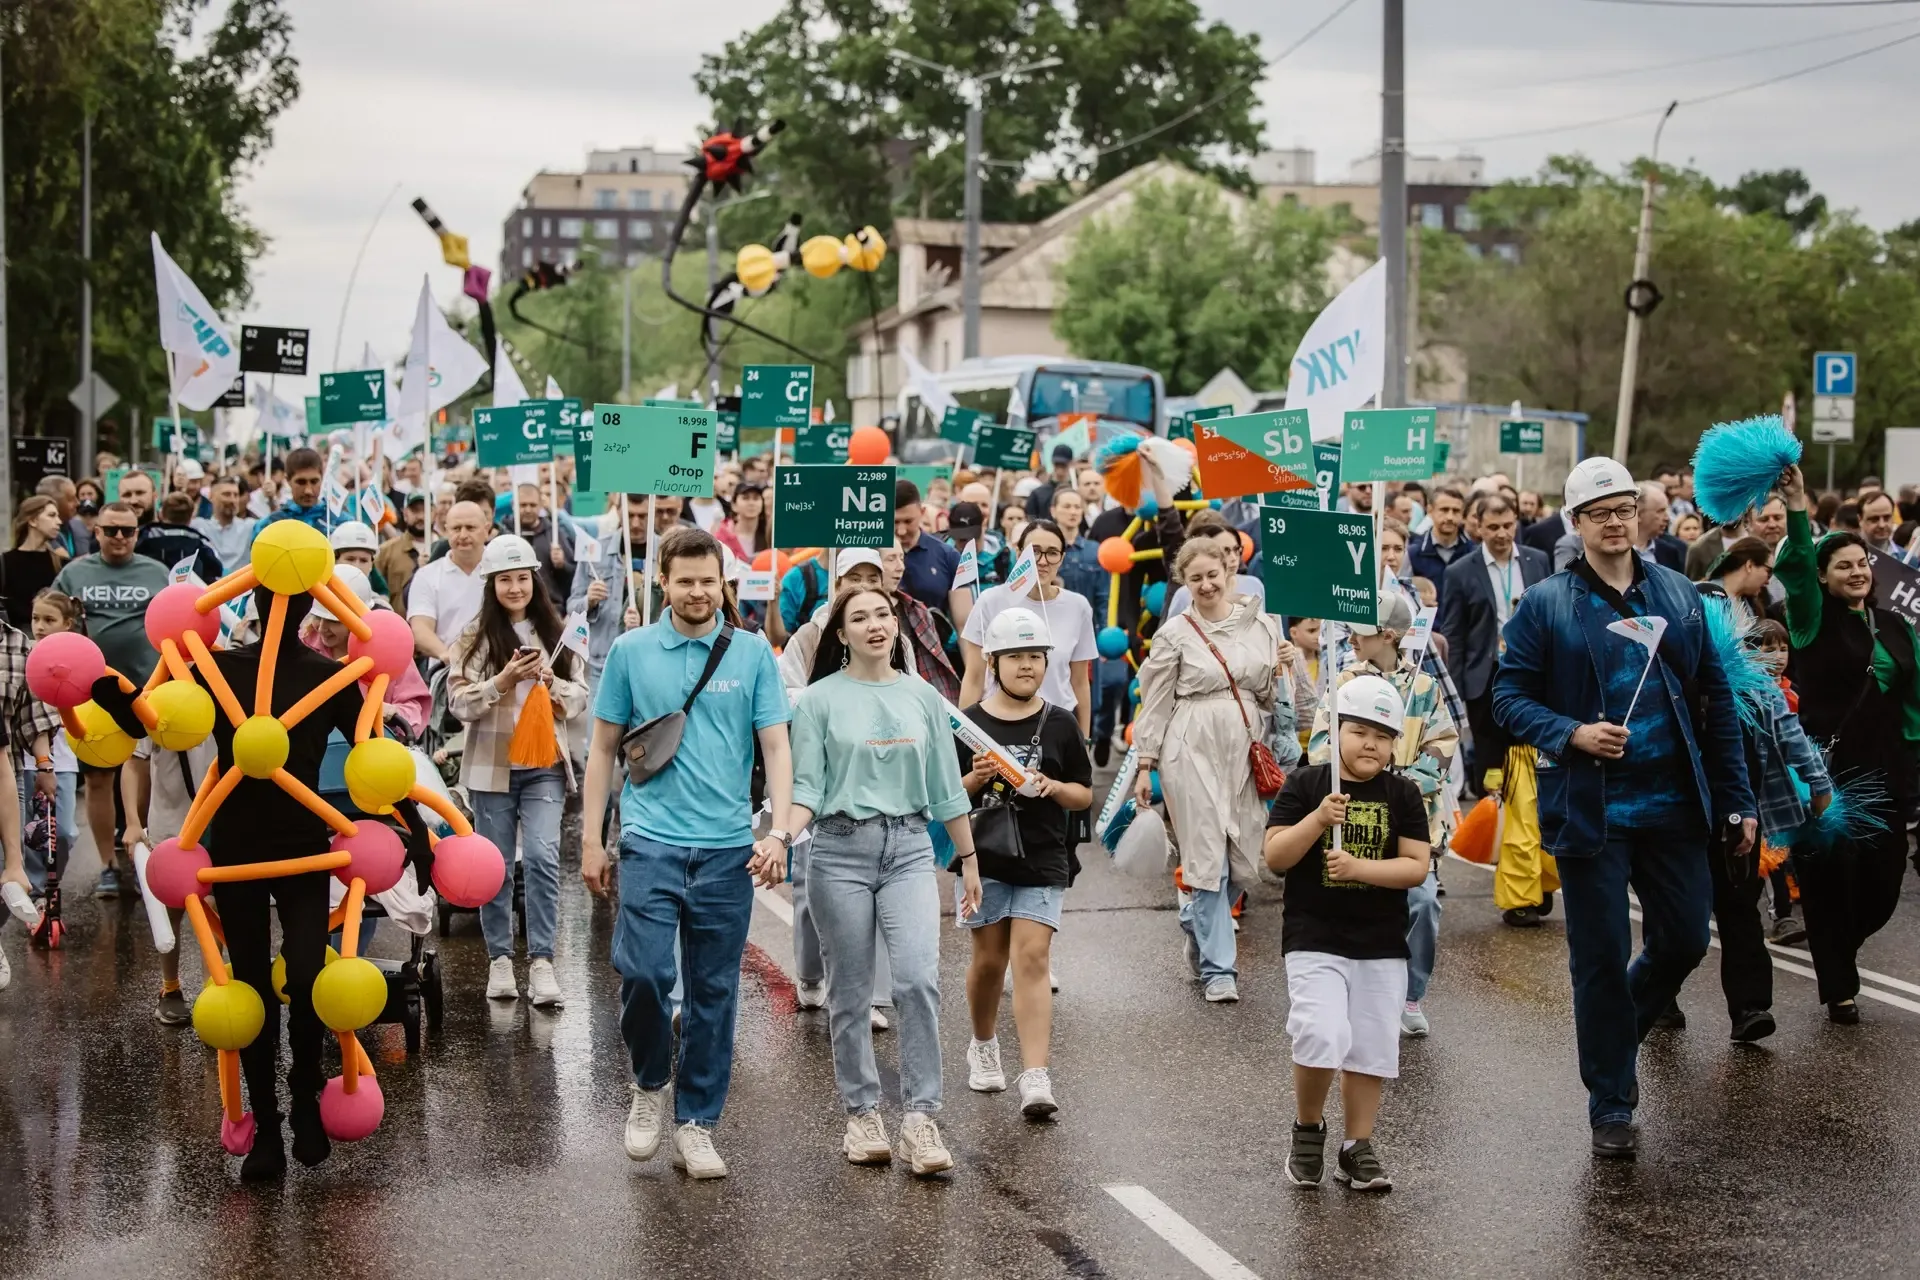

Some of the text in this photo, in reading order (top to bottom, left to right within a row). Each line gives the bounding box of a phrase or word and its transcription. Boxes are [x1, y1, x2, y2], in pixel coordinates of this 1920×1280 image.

[277, 338, 305, 357] He
[747, 370, 759, 381] 24
[1826, 357, 1849, 392] P
[368, 381, 382, 399] Y
[785, 380, 809, 402] Cr
[478, 413, 492, 424] 24
[559, 409, 579, 426] Sr
[602, 412, 621, 426] 08
[678, 416, 708, 426] 18,998
[1351, 418, 1365, 430] 01
[522, 418, 547, 440] Cr
[1202, 426, 1220, 439] 51
[691, 432, 708, 458] F
[826, 432, 848, 449] Cu
[1263, 428, 1303, 457] Sb
[1407, 428, 1426, 451] H
[47, 448, 65, 464] Kr
[1383, 456, 1425, 466] Водород
[669, 464, 703, 480] Фтор
[857, 472, 887, 482] 22,989
[1267, 462, 1307, 476] Сурьма
[653, 479, 702, 493] Fluorum
[783, 473, 801, 486] 11
[1273, 474, 1308, 485] Stibium
[1316, 470, 1334, 490] g
[842, 486, 886, 512] Na
[835, 518, 884, 532] Натрий
[1269, 518, 1286, 534] 39
[1338, 524, 1367, 536] 88,905
[835, 534, 883, 545] Natrium
[1346, 541, 1367, 575] Y
[82, 585, 149, 601] KENZO
[1332, 584, 1370, 600] Иттрий
[1890, 581, 1920, 614] He
[1337, 600, 1370, 614] Yttrium
